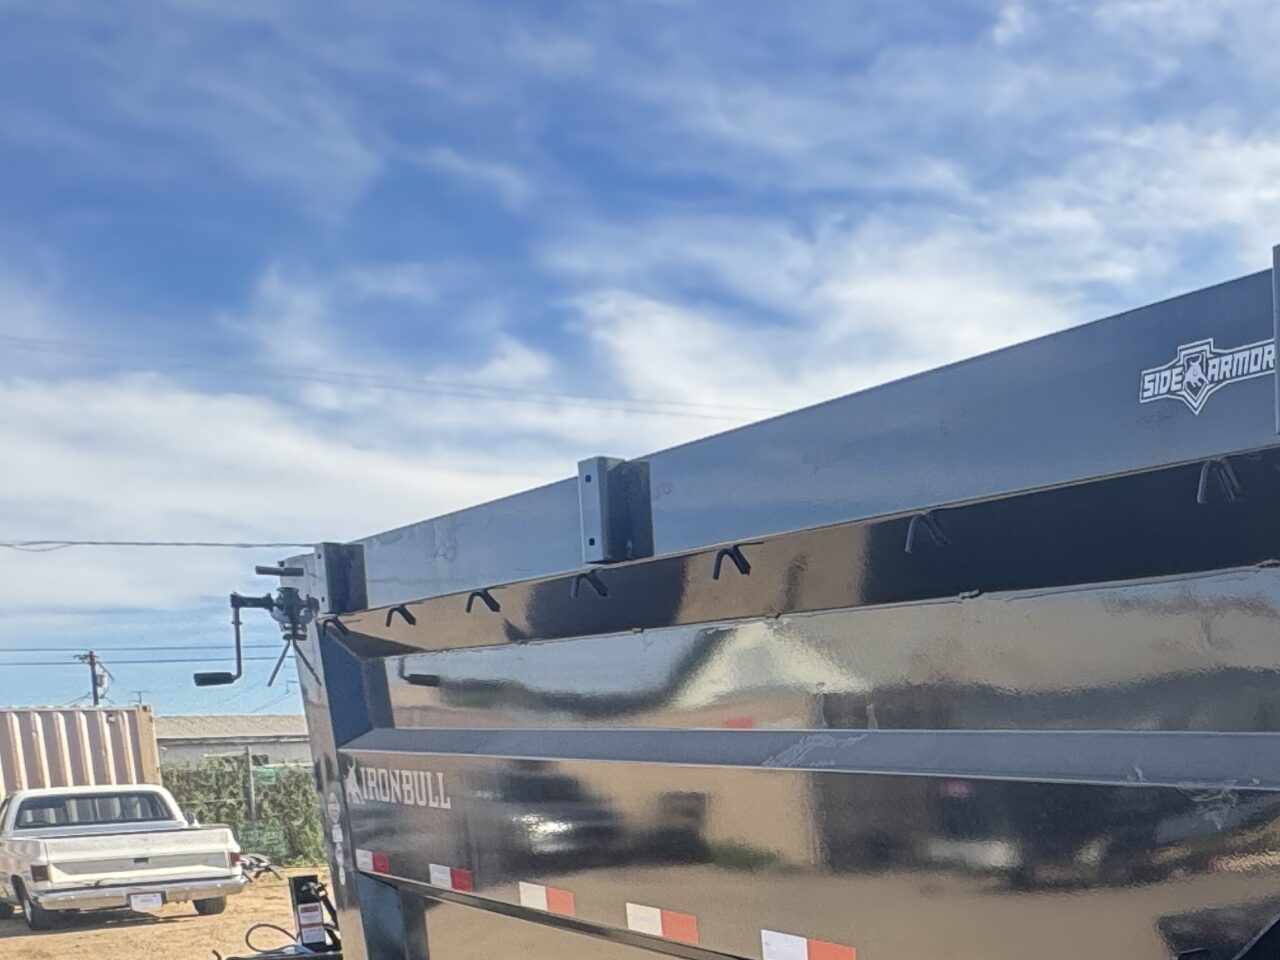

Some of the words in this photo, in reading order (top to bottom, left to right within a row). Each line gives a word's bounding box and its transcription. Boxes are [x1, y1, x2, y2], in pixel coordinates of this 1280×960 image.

[1143, 367, 1184, 398] SIDE
[1207, 344, 1276, 382] ARMOR
[359, 767, 451, 809] IRONBULL
